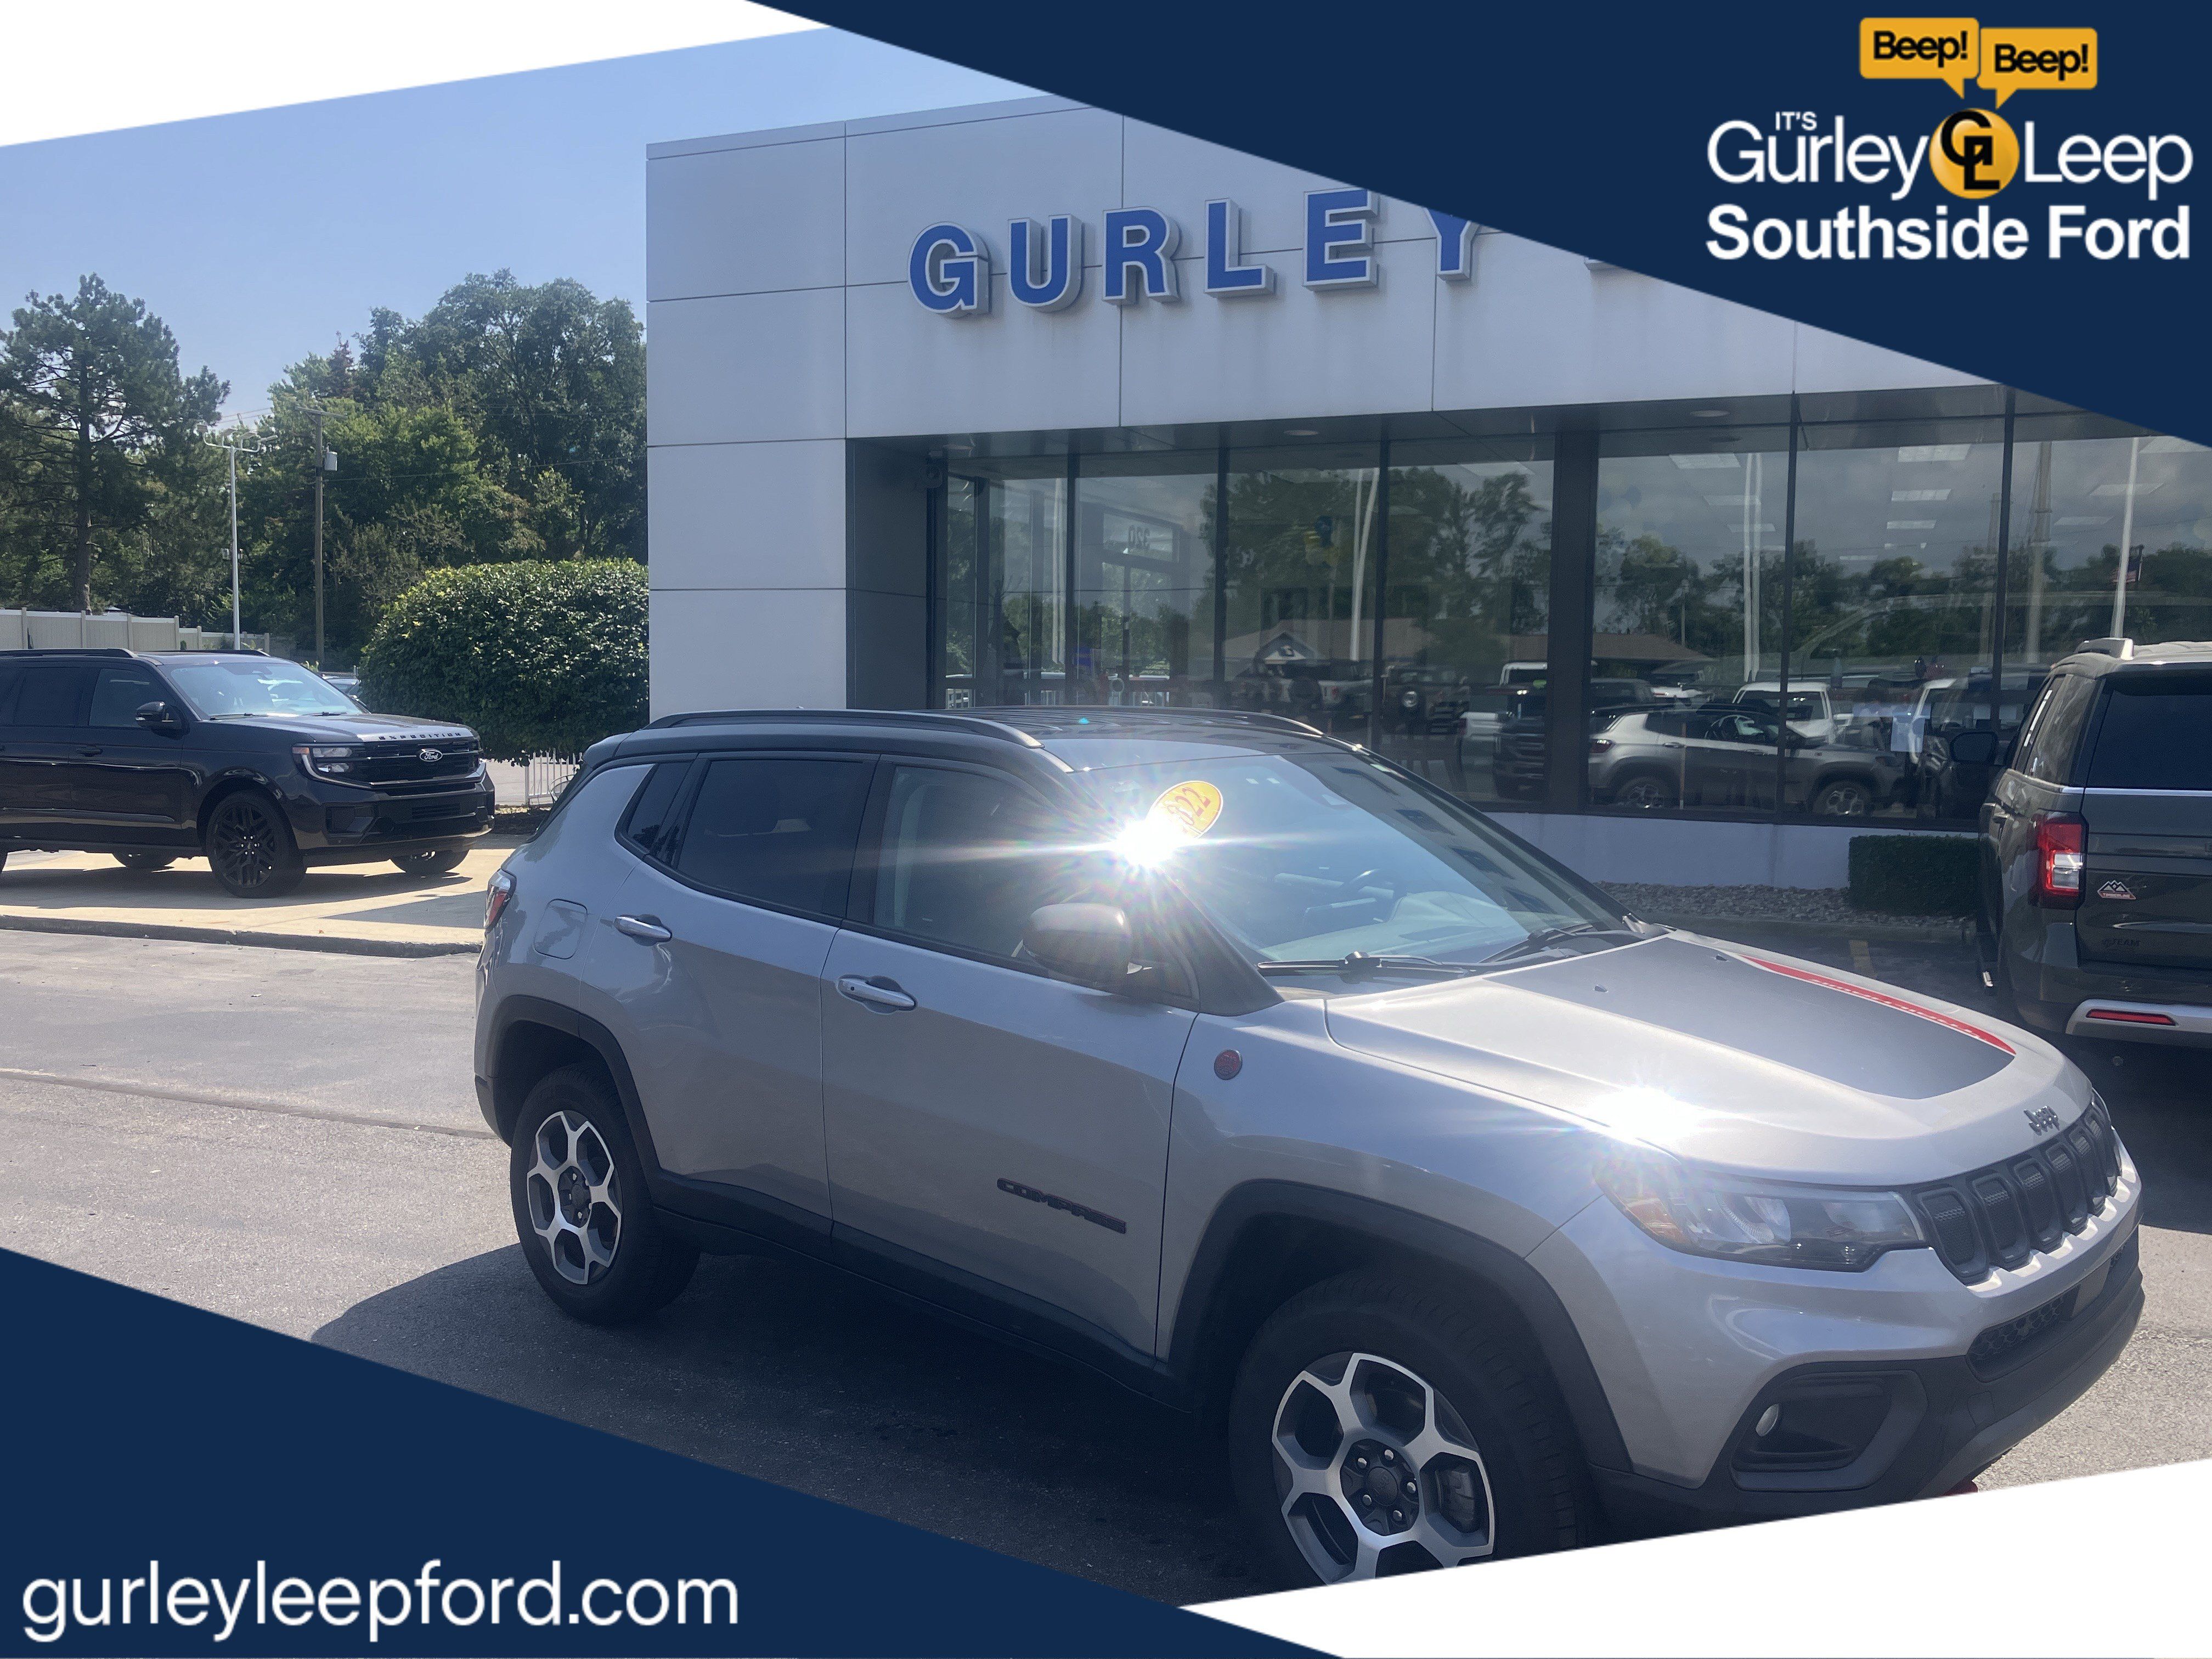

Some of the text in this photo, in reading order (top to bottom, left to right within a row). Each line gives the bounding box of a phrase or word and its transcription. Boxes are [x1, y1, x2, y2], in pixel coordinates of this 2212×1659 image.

[908, 188, 1481, 317] GURLEY
[378, 732, 461, 740] EXPEDITION
[997, 1178, 1127, 1234] COMPASS
